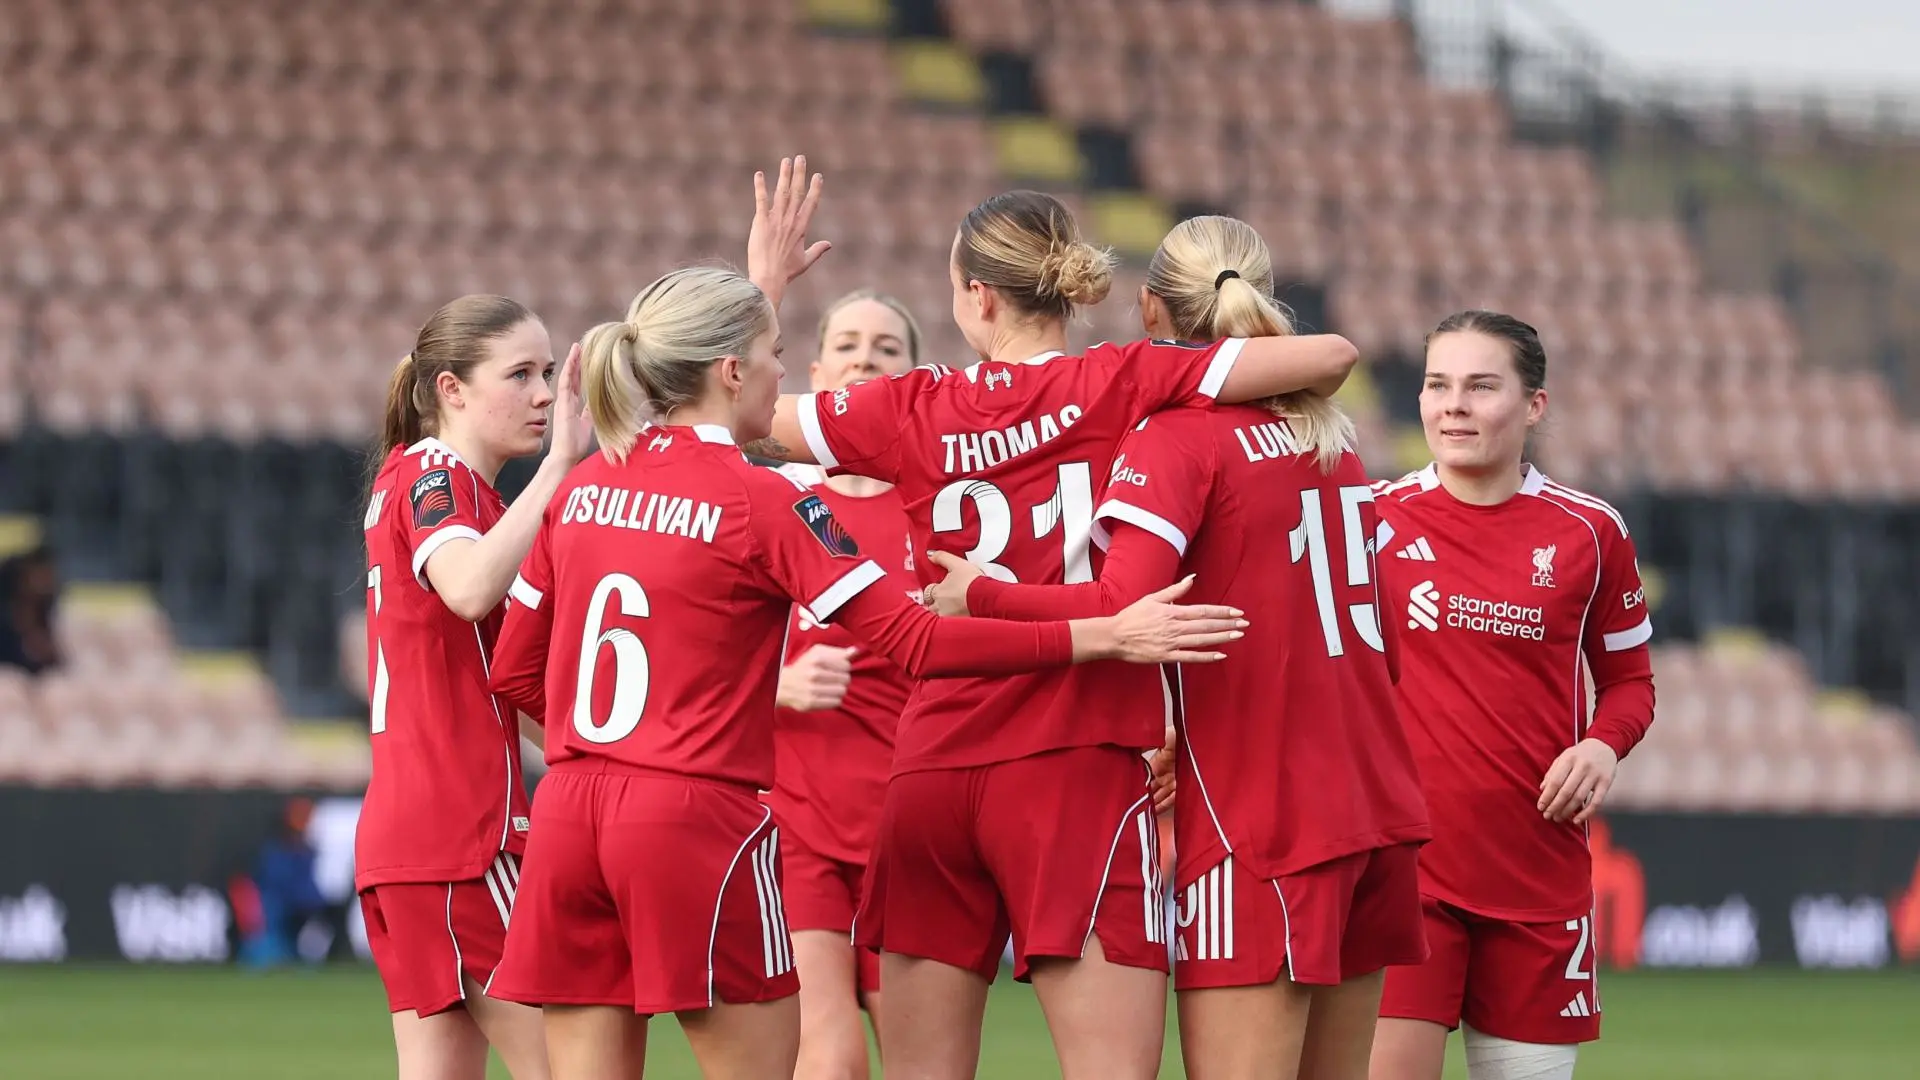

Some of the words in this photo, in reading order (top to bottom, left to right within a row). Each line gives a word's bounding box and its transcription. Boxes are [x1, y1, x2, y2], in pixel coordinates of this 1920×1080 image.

[1233, 420, 1312, 463] LUN
[1108, 466, 1147, 487] dia
[561, 484, 723, 544] O'SULLIVAN
[932, 461, 1094, 584] 31
[1288, 485, 1385, 658] 15
[1447, 593, 1543, 624] standard
[1622, 586, 1644, 610] Exp
[1446, 610, 1545, 641] chartered
[573, 572, 650, 744] 6
